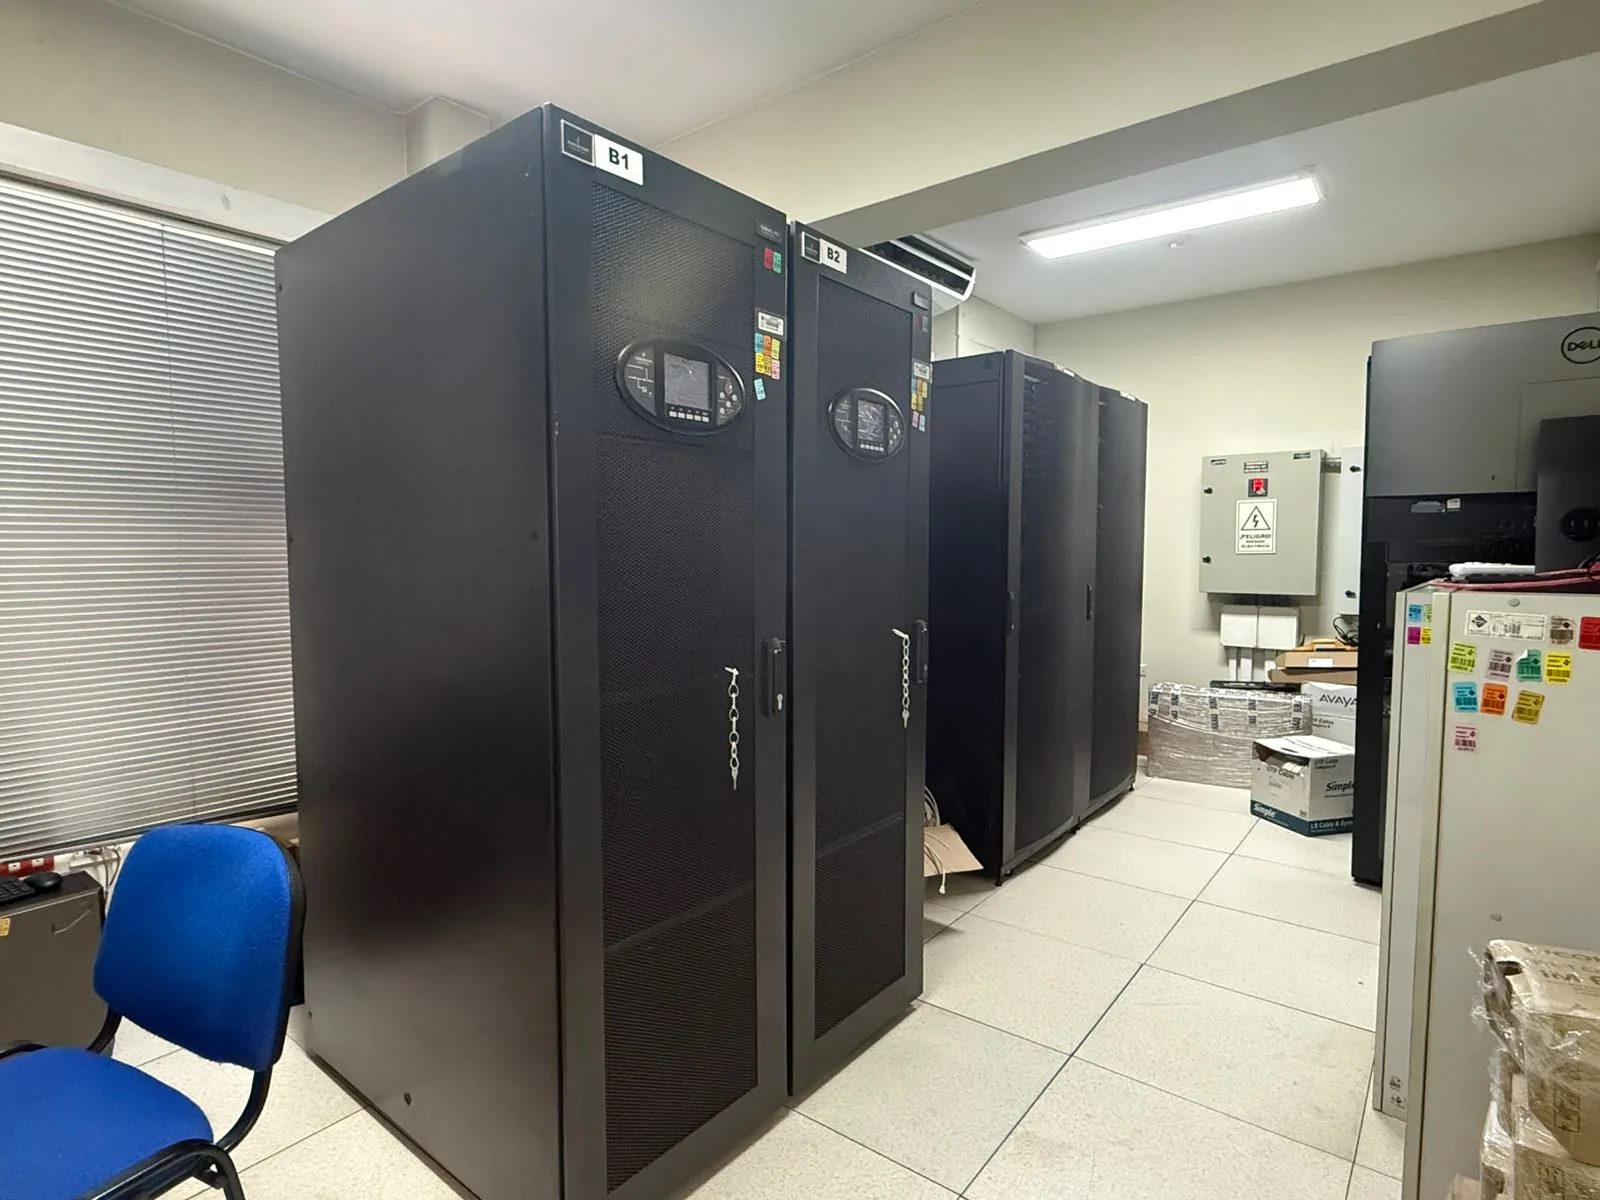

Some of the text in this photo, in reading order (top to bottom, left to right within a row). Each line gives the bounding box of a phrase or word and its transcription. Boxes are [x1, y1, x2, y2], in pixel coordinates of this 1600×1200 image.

[608, 146, 629, 170] B1
[827, 246, 841, 264] B2
[1319, 694, 1357, 708] AVAYA
